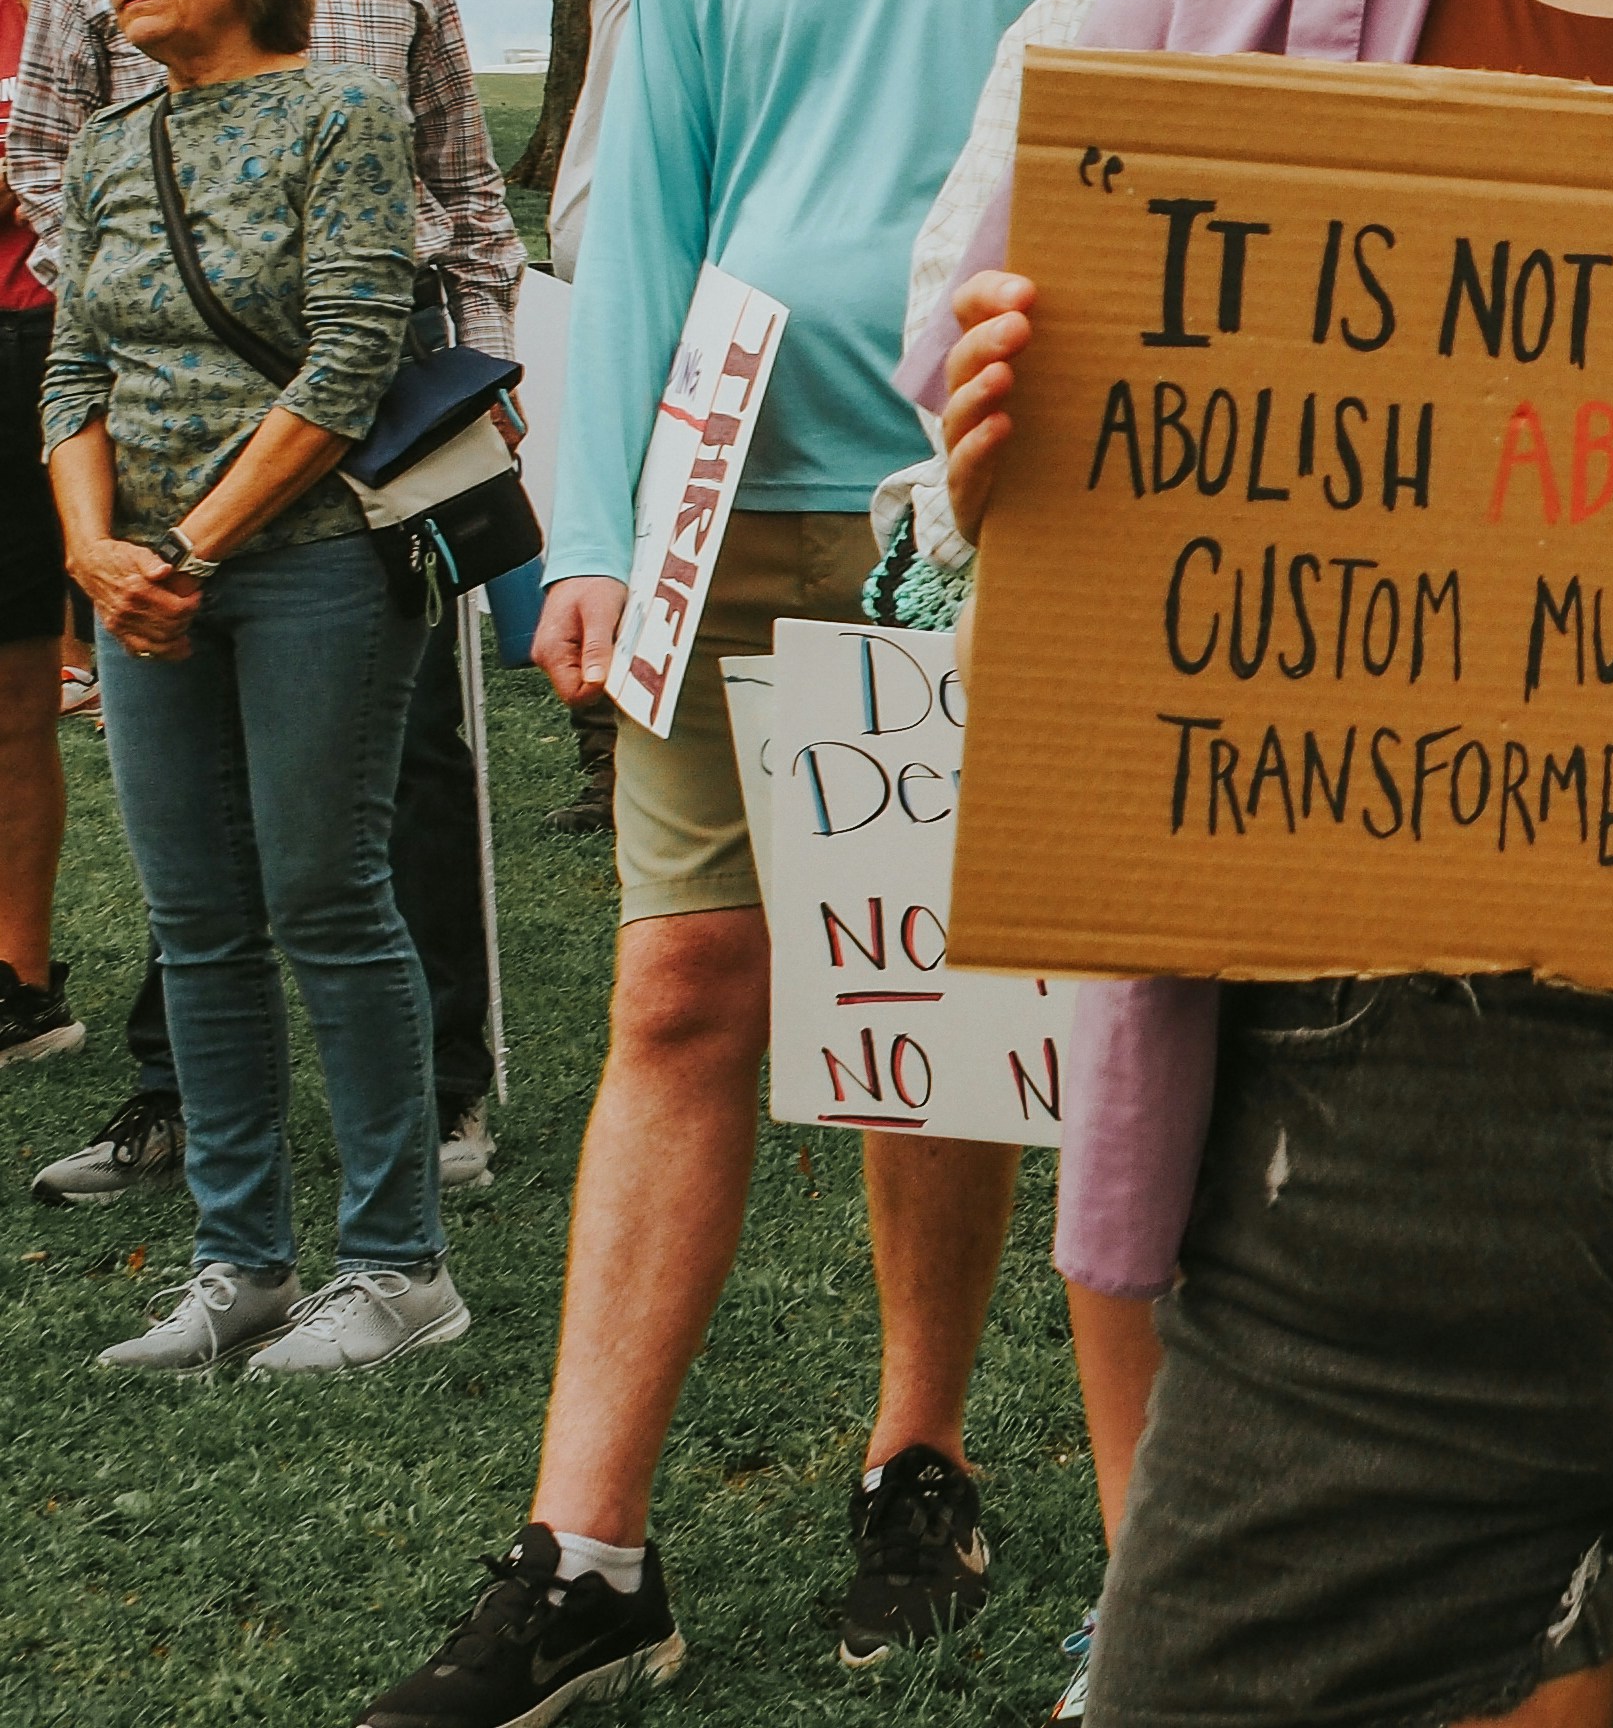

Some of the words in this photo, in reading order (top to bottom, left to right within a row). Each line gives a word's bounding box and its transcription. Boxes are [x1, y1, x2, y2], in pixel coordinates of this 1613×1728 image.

[1311, 219, 1396, 352] IS
[1438, 237, 1613, 370] NOT
[1087, 379, 1435, 511] ABOLISH
[1164, 536, 1462, 684] CUSTOM
[822, 1027, 933, 1109] NO
